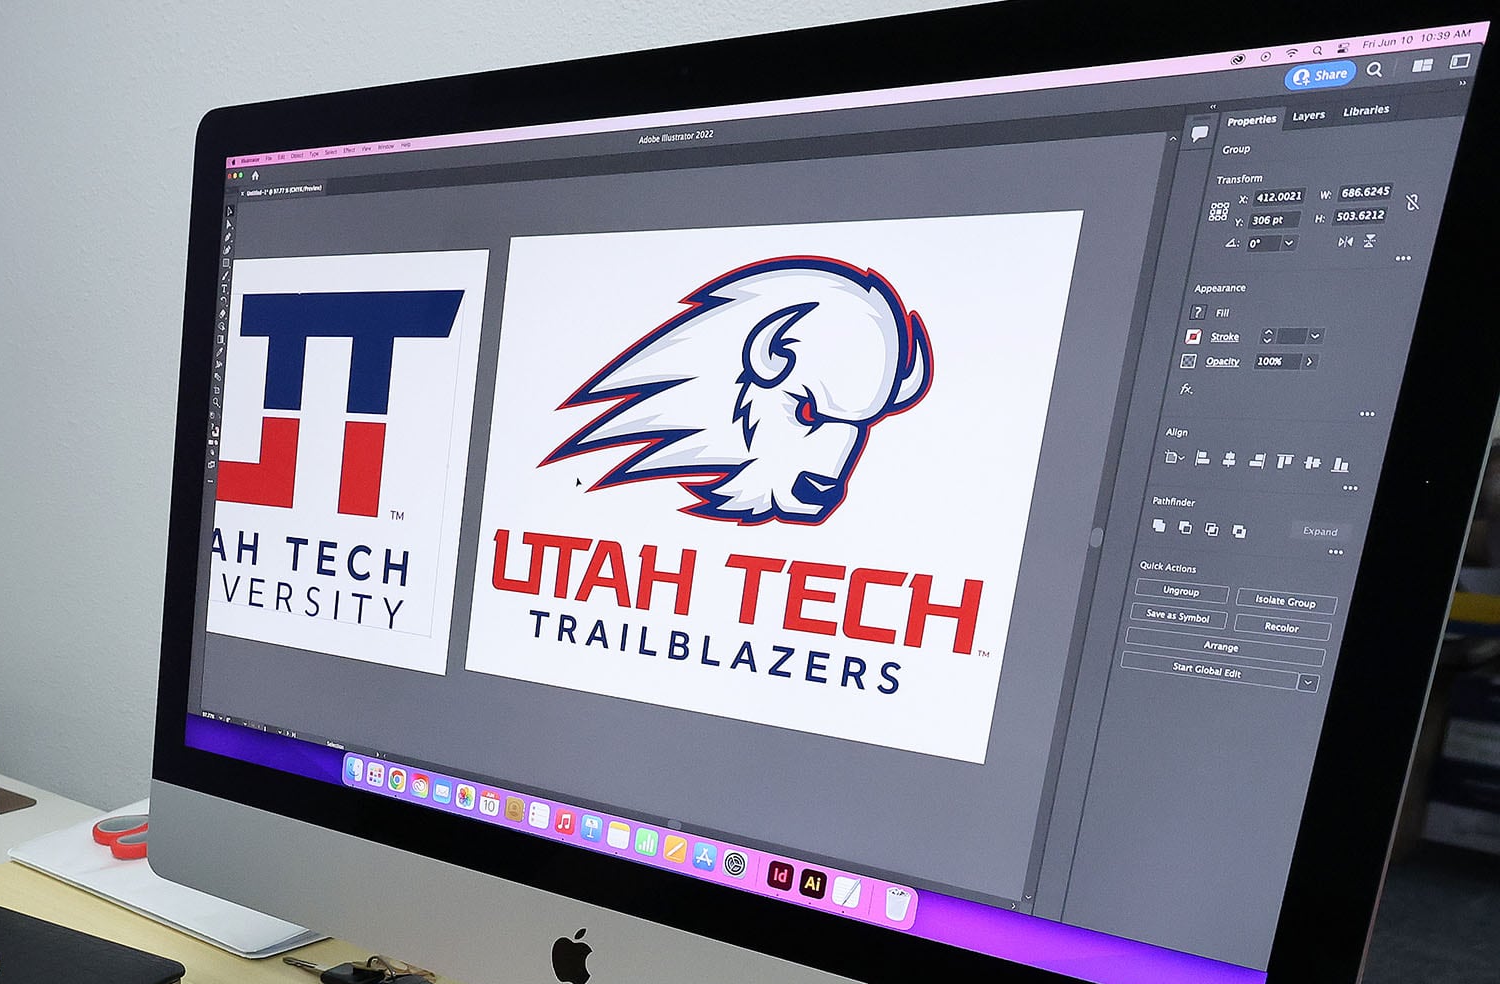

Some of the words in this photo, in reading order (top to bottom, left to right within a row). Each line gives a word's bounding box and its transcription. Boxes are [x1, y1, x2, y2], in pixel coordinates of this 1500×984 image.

[1362, 39, 1376, 50] Fri
[1378, 37, 1397, 48] Jun
[1401, 35, 1413, 45] 10
[1420, 31, 1450, 43] 10:39
[1453, 28, 1472, 39] AM
[1314, 68, 1348, 82] Share
[1227, 113, 1277, 127] Properties
[1292, 109, 1326, 123] Layers
[1343, 104, 1390, 118] Libraries
[638, 136, 660, 144] Adobe
[661, 132, 695, 142] Illustrator
[695, 130, 714, 139] 2022
[1222, 144, 1251, 157] Group
[1216, 173, 1263, 185] Transform
[1239, 195, 1249, 204] X:
[1256, 190, 1302, 202] 412.0021
[1320, 190, 1332, 200] W:
[1341, 185, 1390, 198] 686.6245
[1234, 218, 1244, 228] Y:
[1251, 215, 1270, 226] 306
[1271, 215, 1284, 227] pt
[1315, 214, 1326, 223] H:
[1336, 209, 1385, 222] 503.6212
[1194, 284, 1247, 294] Appearance
[1215, 309, 1230, 318] Fill
[1210, 332, 1240, 342] Stroke
[1205, 357, 1240, 368] Opacity
[1257, 357, 1282, 366] 100%
[1165, 428, 1188, 438] Align
[1152, 496, 1196, 507] Pathfinder
[391, 510, 404, 521] TM
[1303, 526, 1338, 537] Expand
[286, 536, 409, 587] TECH
[1140, 560, 1163, 570] Quick
[1165, 563, 1197, 574] Actions
[492, 529, 697, 616] UTAH
[725, 553, 984, 655] TECH
[1163, 585, 1200, 598] Ungroup
[222, 573, 404, 630] VERSITY
[1255, 594, 1285, 606] Isolate
[1287, 598, 1316, 610] Group
[1146, 609, 1166, 620] Save
[1167, 612, 1177, 620] as
[1178, 611, 1210, 624] Symbol
[1264, 621, 1300, 633] Recolor
[529, 609, 902, 695] TRAILBLAZERS
[1203, 640, 1239, 653] Arrange
[1172, 662, 1193, 672] Start
[1194, 664, 1222, 676] Global
[1224, 669, 1242, 679] Edit
[483, 799, 496, 813] 10
[774, 868, 788, 883] Id
[804, 876, 821, 891] Ai
